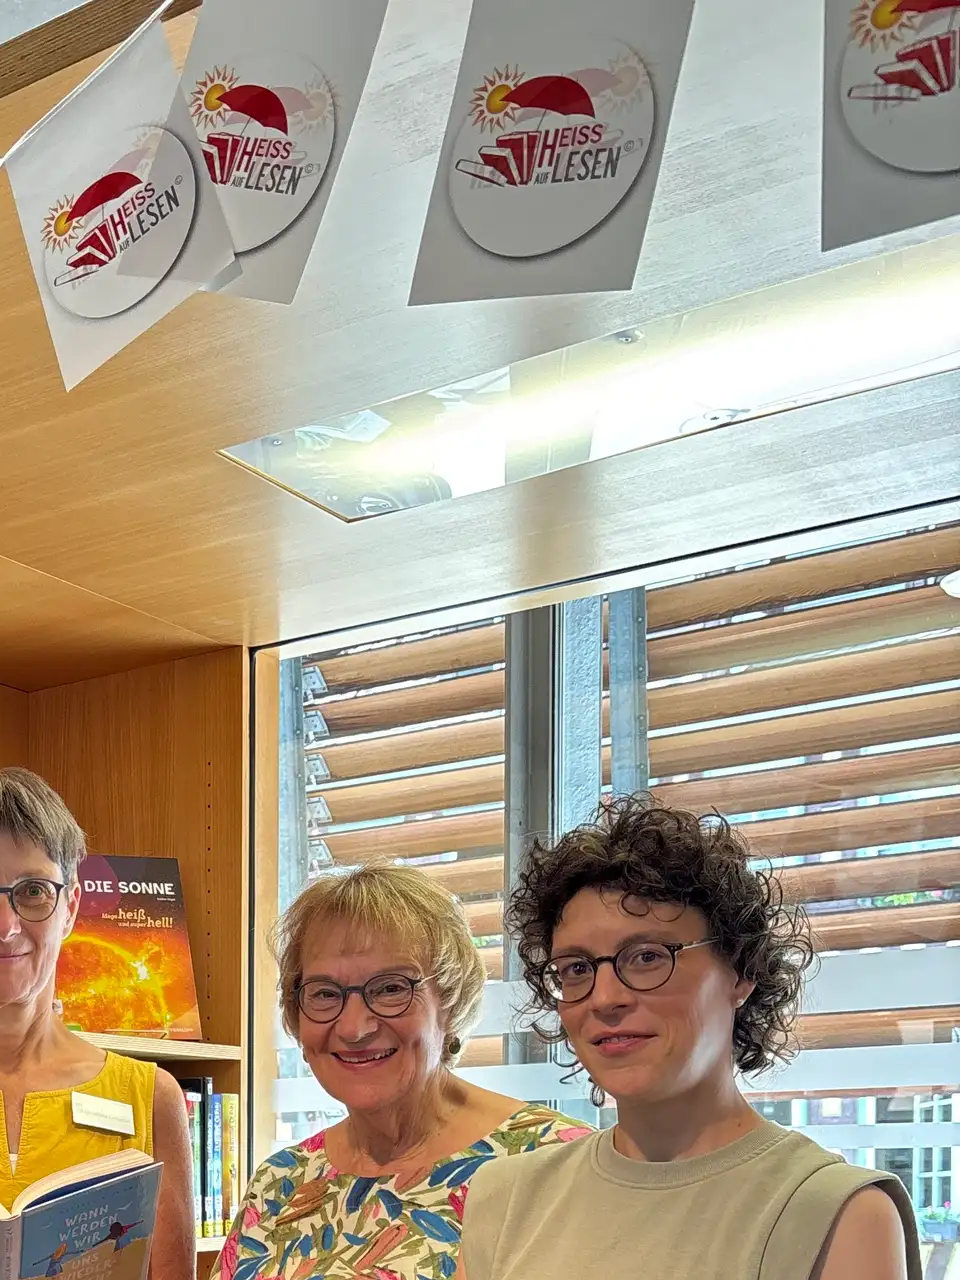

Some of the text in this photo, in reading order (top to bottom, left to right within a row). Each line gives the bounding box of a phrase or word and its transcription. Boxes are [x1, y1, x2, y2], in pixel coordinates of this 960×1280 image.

[239, 136, 293, 173] HEISS
[538, 123, 604, 168] HEISS
[110, 181, 156, 243] HEISS
[84, 880, 175, 895] DIE SONNE
[59, 1213, 118, 1241] WERDEN
[65, 1205, 108, 1227] WANN
[74, 1231, 101, 1248] WIR
[72, 1253, 99, 1269] UNS
